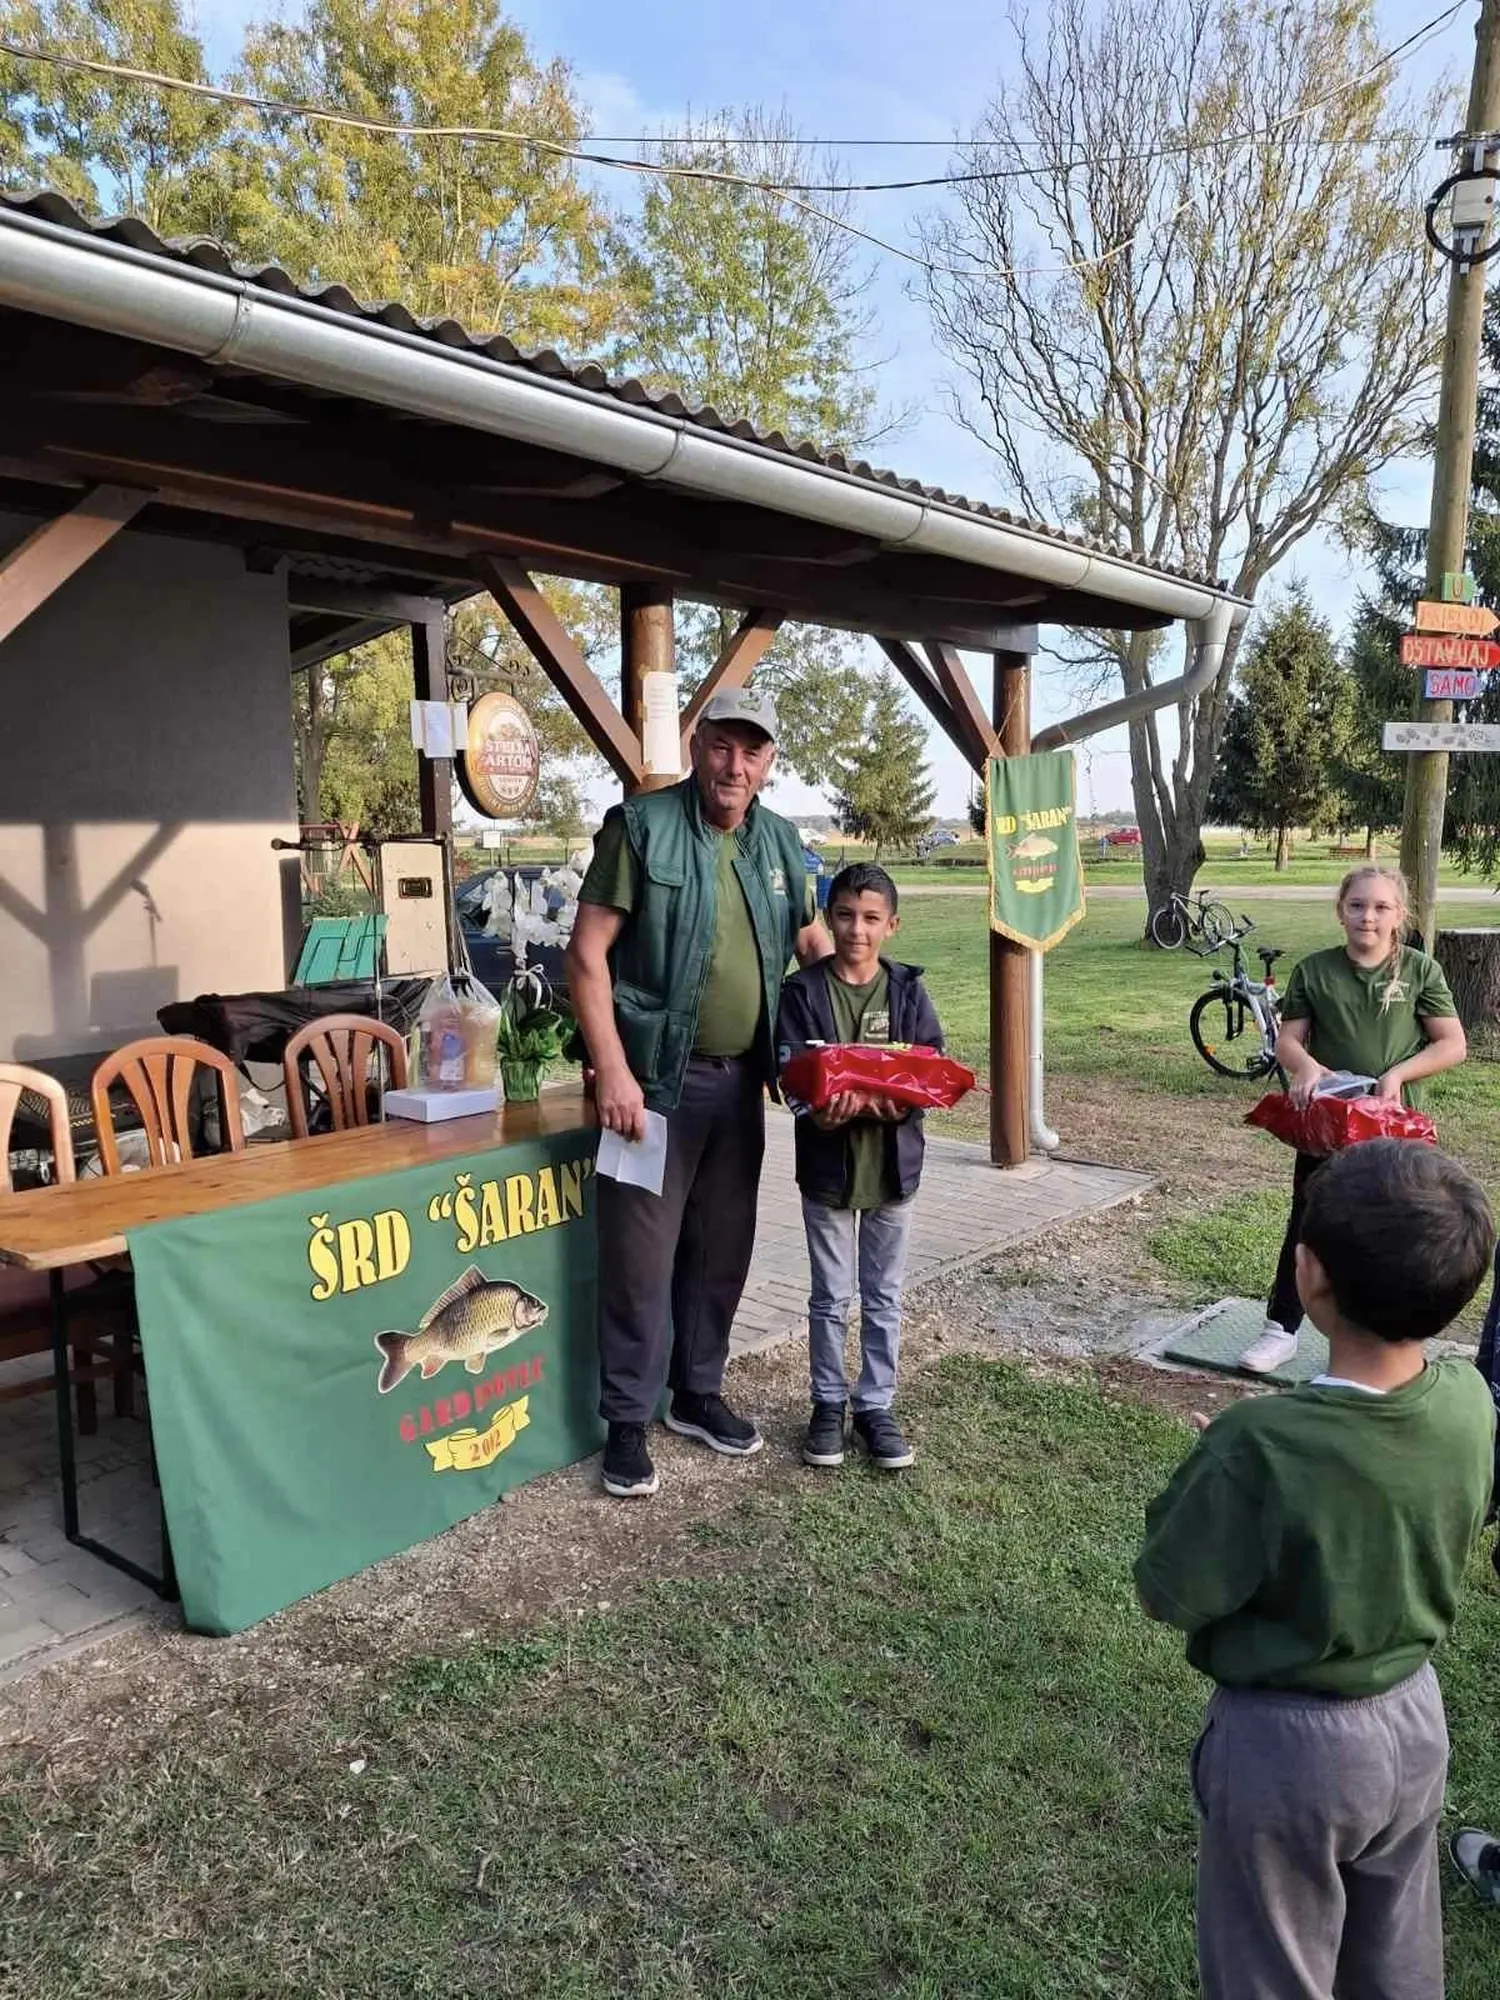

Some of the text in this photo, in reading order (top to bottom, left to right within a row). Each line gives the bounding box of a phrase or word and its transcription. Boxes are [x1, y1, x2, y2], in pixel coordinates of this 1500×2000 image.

[1430, 672, 1476, 696] SAMO
[308, 1209, 412, 1302] ŠRD
[469, 1429, 501, 1462] 2012
